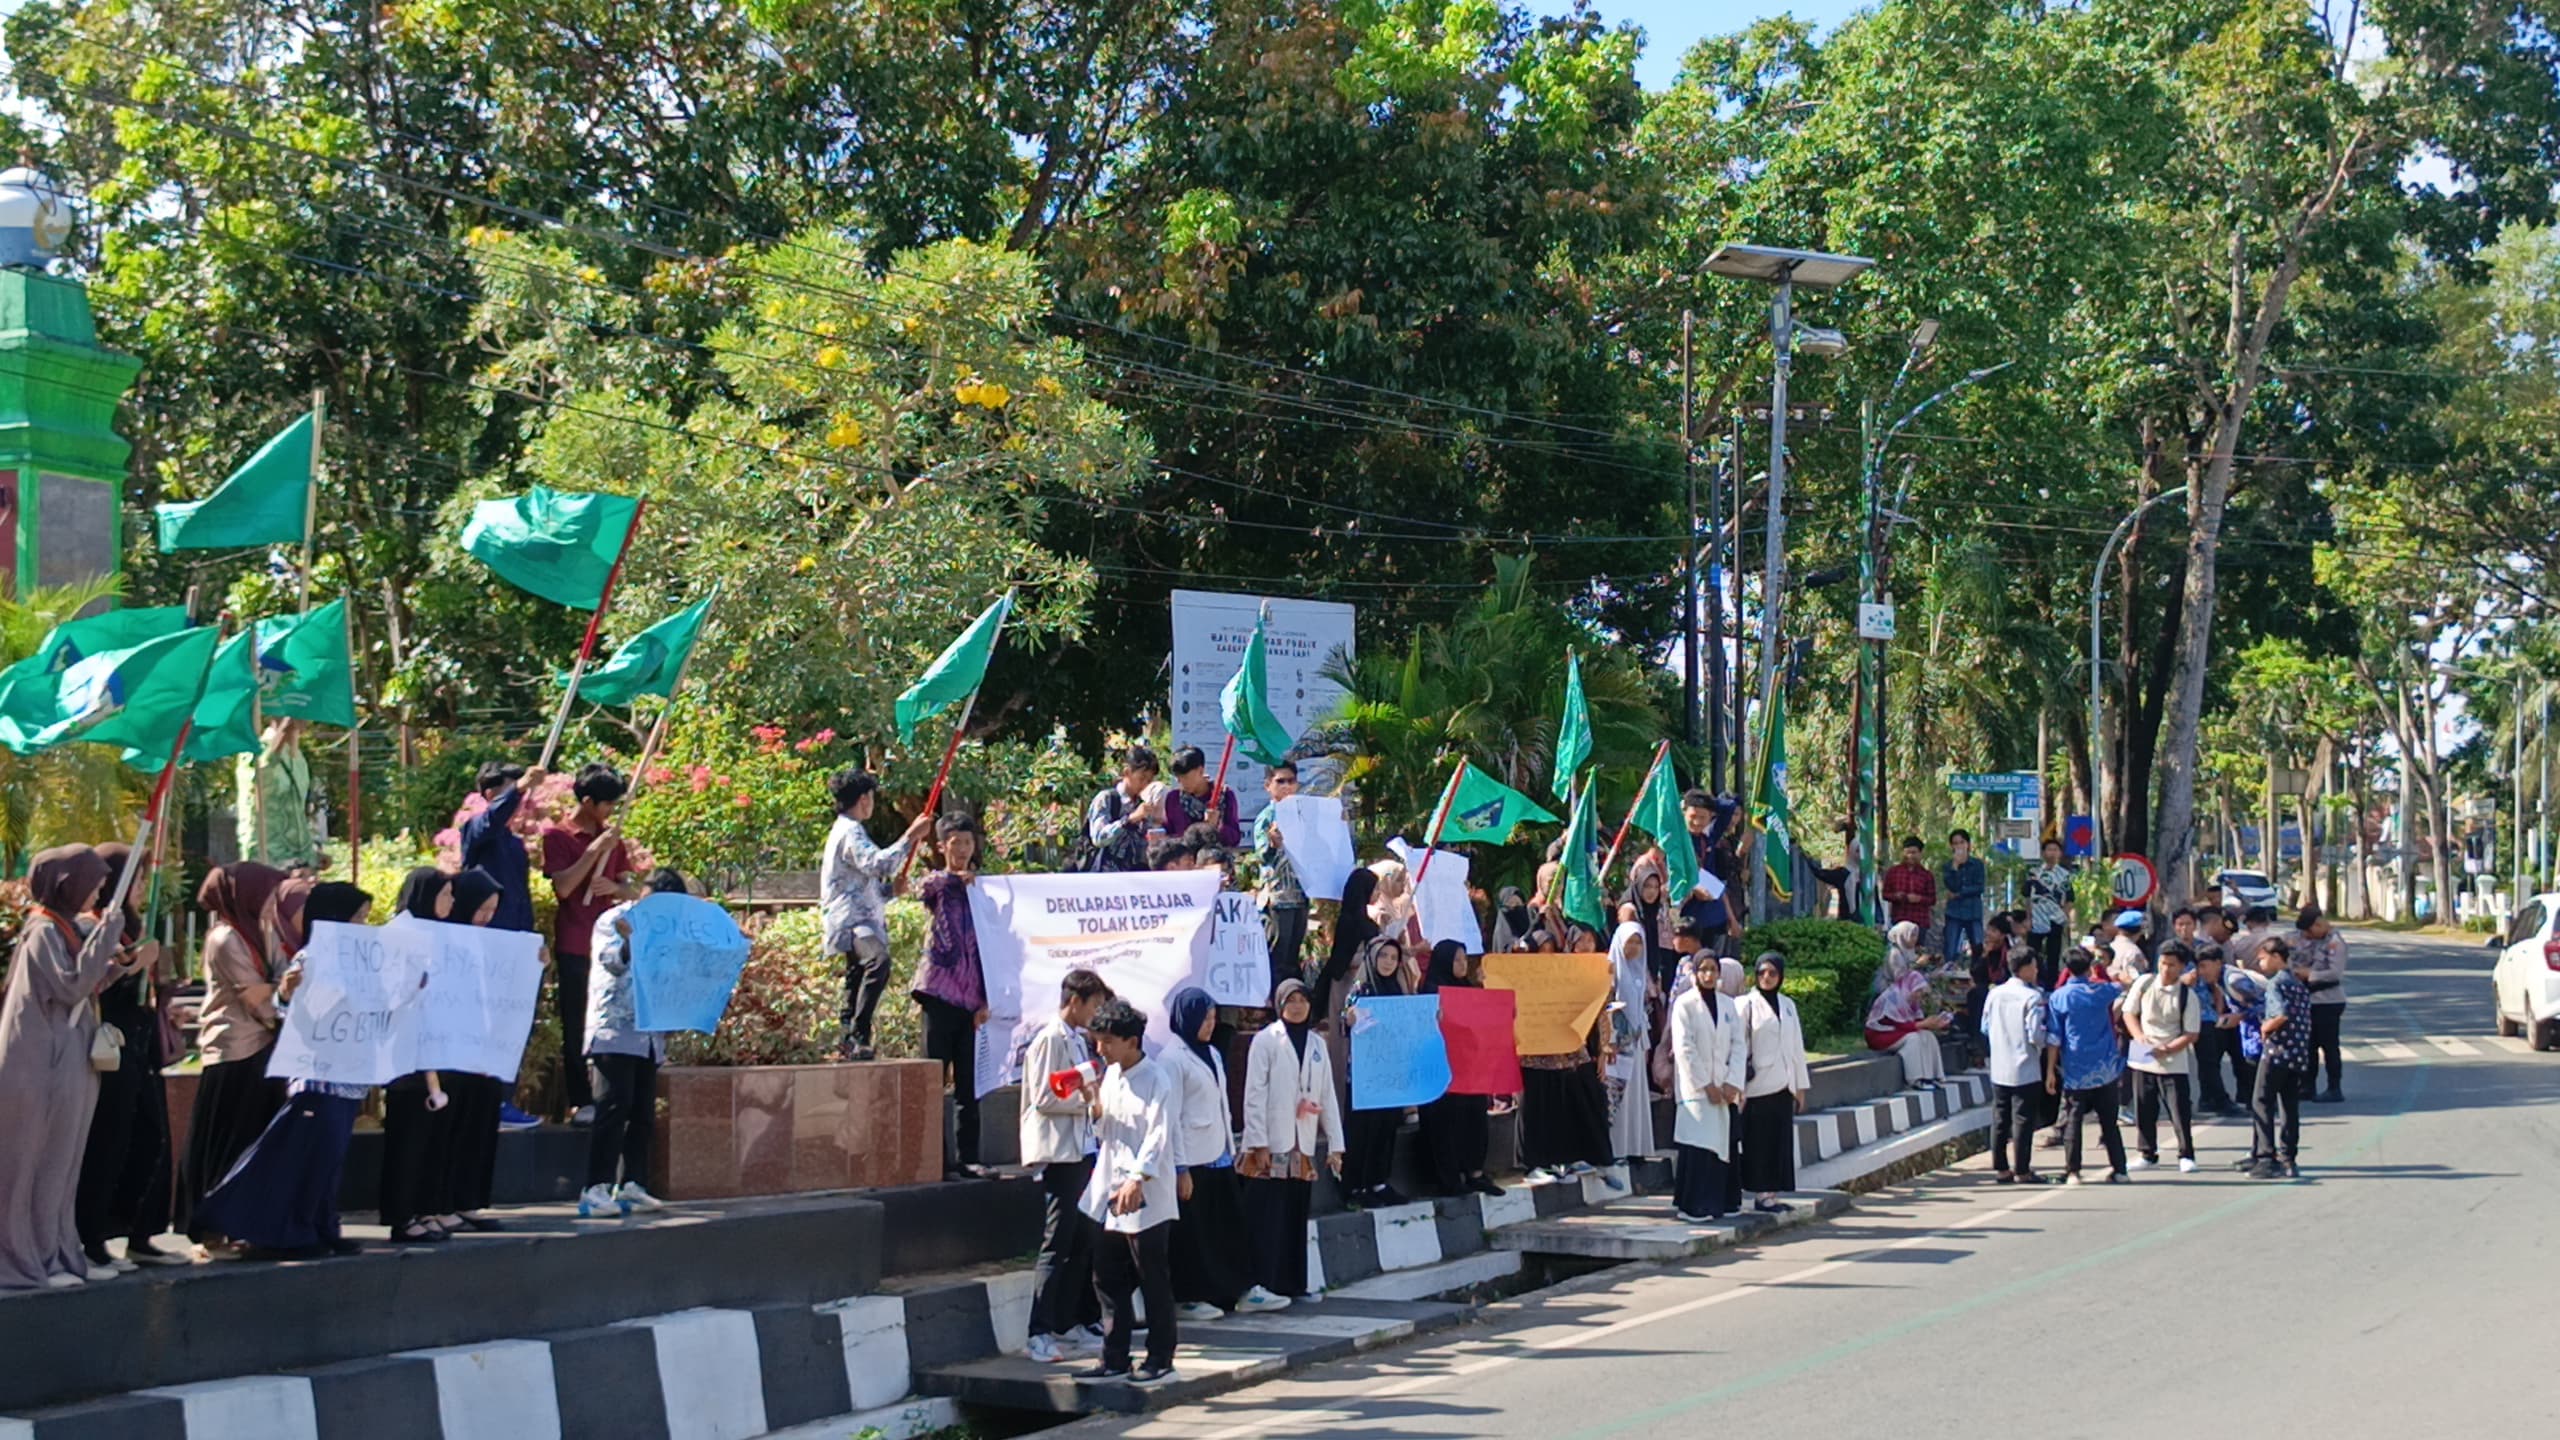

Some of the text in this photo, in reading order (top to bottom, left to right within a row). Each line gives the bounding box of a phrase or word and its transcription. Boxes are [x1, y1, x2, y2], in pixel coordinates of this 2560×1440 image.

[2114, 869, 2135, 898] 40
[1046, 893, 1195, 914] DEKLARASI PELAJAR
[1078, 914, 1169, 934] TOLAK LGBT
[1209, 962, 1257, 995] GBT
